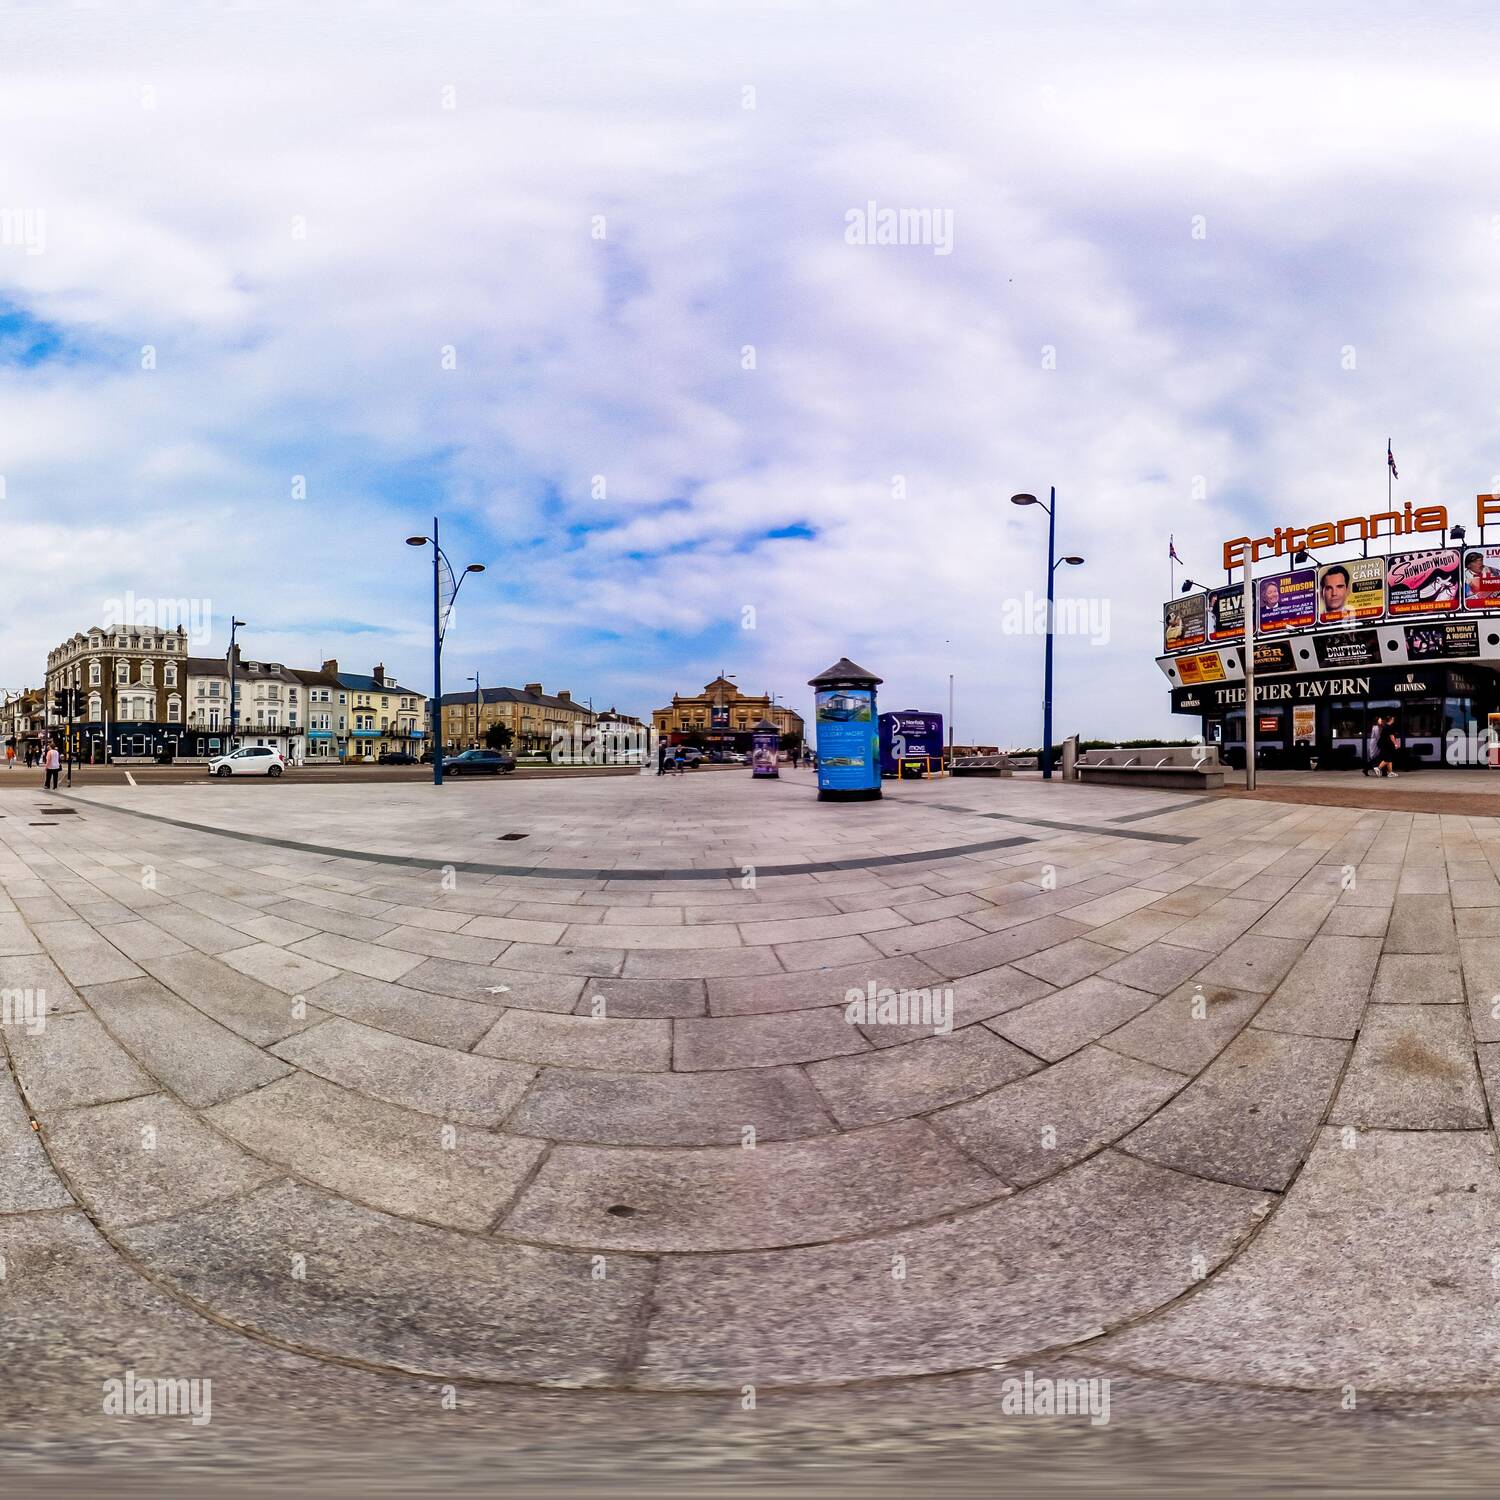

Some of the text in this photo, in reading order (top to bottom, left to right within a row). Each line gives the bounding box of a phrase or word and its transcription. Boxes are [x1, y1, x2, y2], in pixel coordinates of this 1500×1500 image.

[1353, 563, 1379, 571] JIMMY
[1353, 569, 1380, 579] CARR
[1280, 578, 1291, 586] JIM
[1280, 581, 1314, 594] DAVIDSON
[1327, 644, 1367, 657] DRIFTERS
[1215, 677, 1371, 704] THE PIER TAVERN
[1394, 682, 1426, 692] GUINNESS
